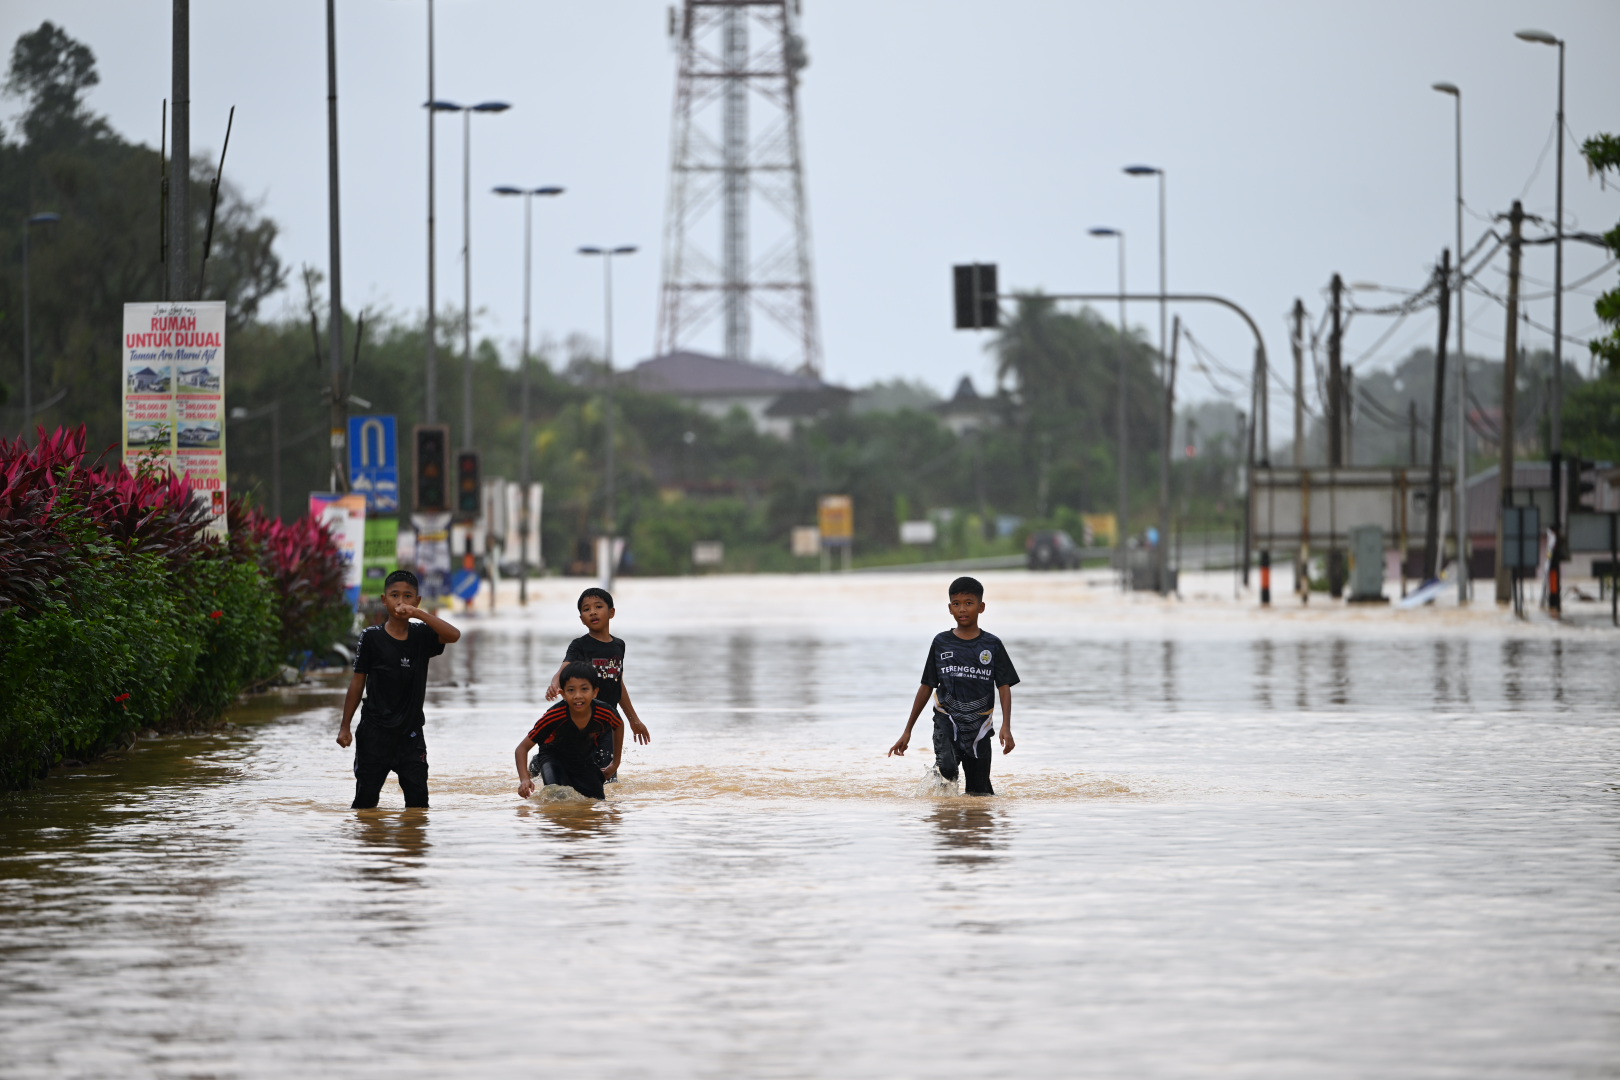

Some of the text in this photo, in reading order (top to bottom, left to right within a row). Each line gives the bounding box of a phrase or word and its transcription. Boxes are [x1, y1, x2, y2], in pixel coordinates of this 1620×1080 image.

[151, 317, 196, 331] RUMAH
[126, 332, 222, 348] UNTUK DIJUAL
[130, 350, 157, 361] Taman
[158, 349, 173, 360] Ara
[941, 665, 992, 676] TERENGGANU
